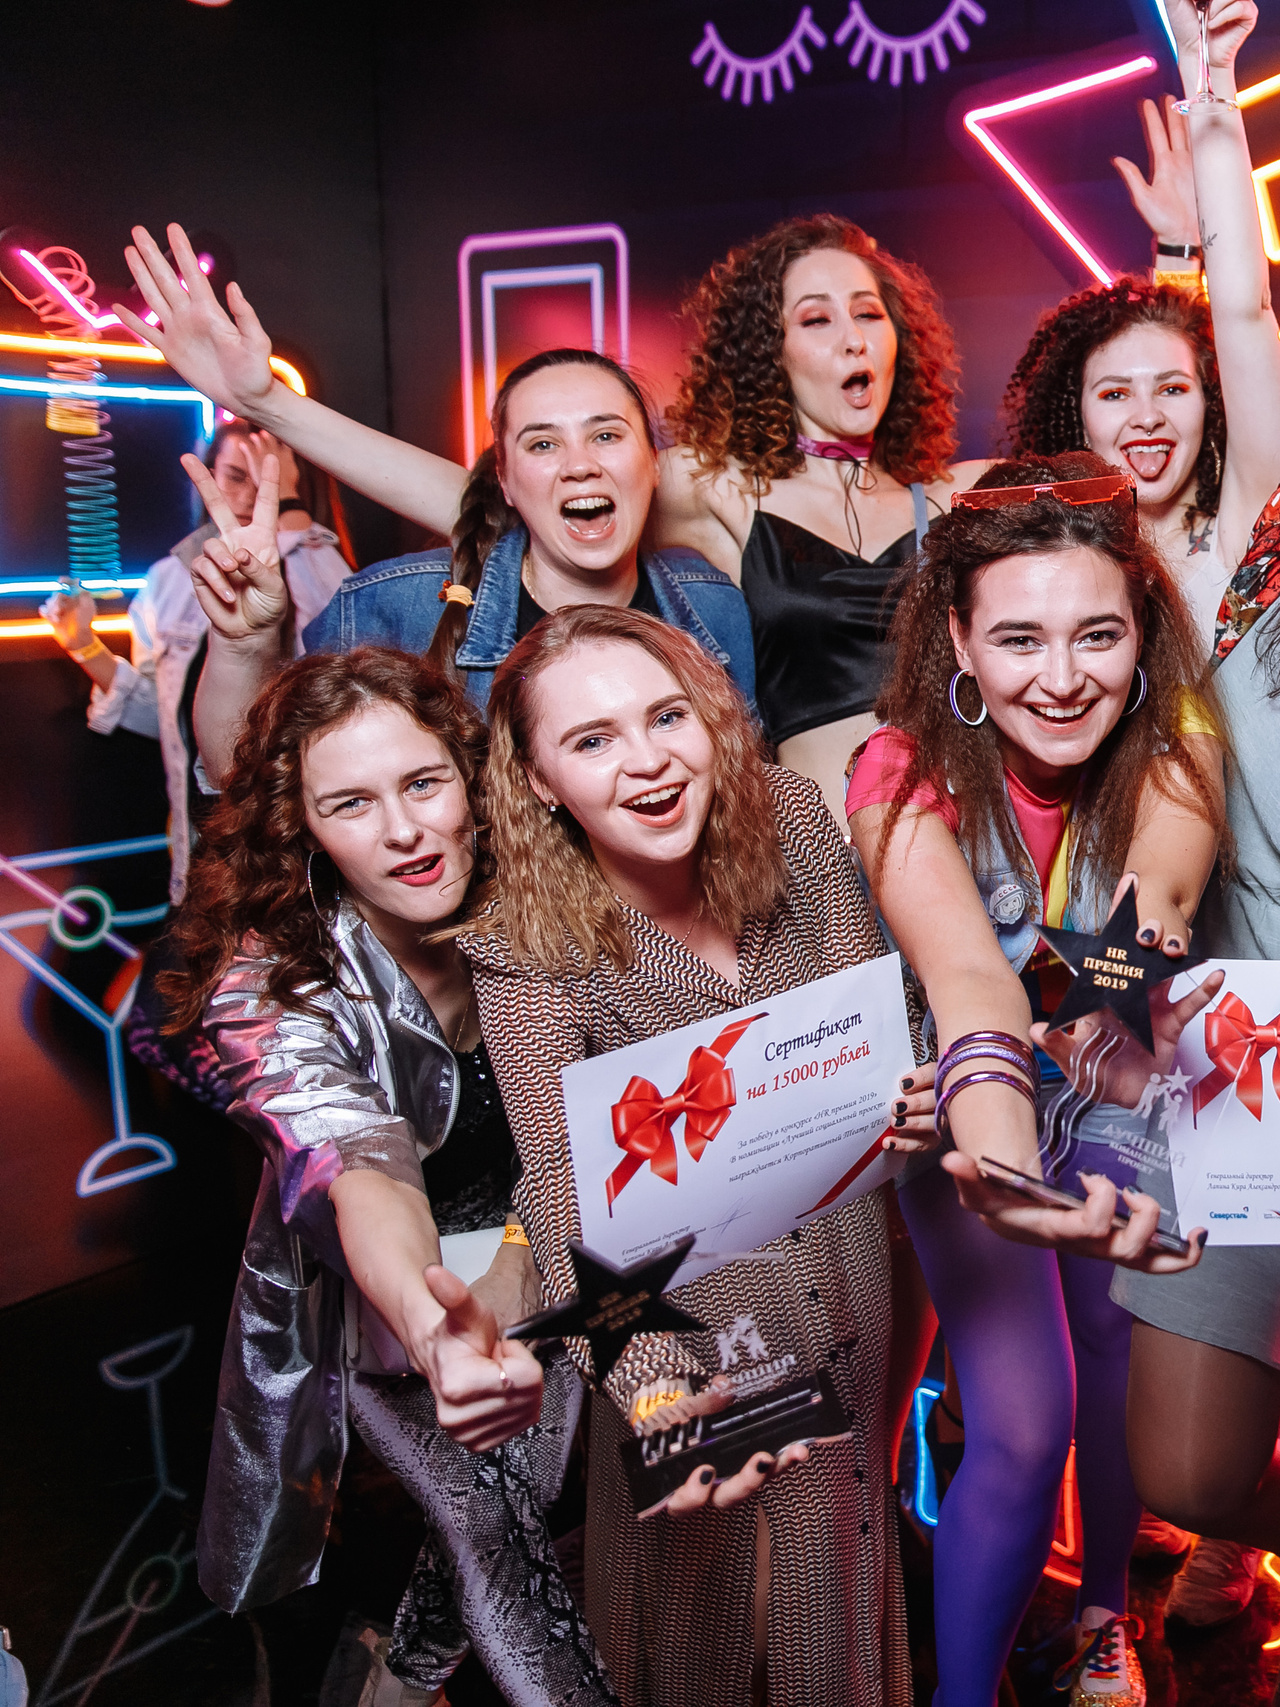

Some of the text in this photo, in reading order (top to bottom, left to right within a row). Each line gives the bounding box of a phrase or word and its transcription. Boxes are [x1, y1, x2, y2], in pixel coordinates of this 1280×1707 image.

[1083, 957, 1145, 980] ПРЕМИЯ
[1106, 947, 1128, 962] HR
[1094, 974, 1129, 991] 2019
[765, 1012, 862, 1062] Сертификат
[746, 1040, 871, 1101] на 15000 рублей
[729, 1155, 737, 1164] В
[738, 1140, 780, 1161] номинации
[815, 1111, 857, 1134] социальный
[737, 1140, 747, 1149] За
[749, 1129, 774, 1146] победу
[780, 1116, 812, 1133] конкурсе
[831, 1100, 857, 1117] премия
[729, 1158, 782, 1183] награждается
[783, 1134, 842, 1162] Корпоративный
[1209, 1211, 1248, 1220] Северсталь
